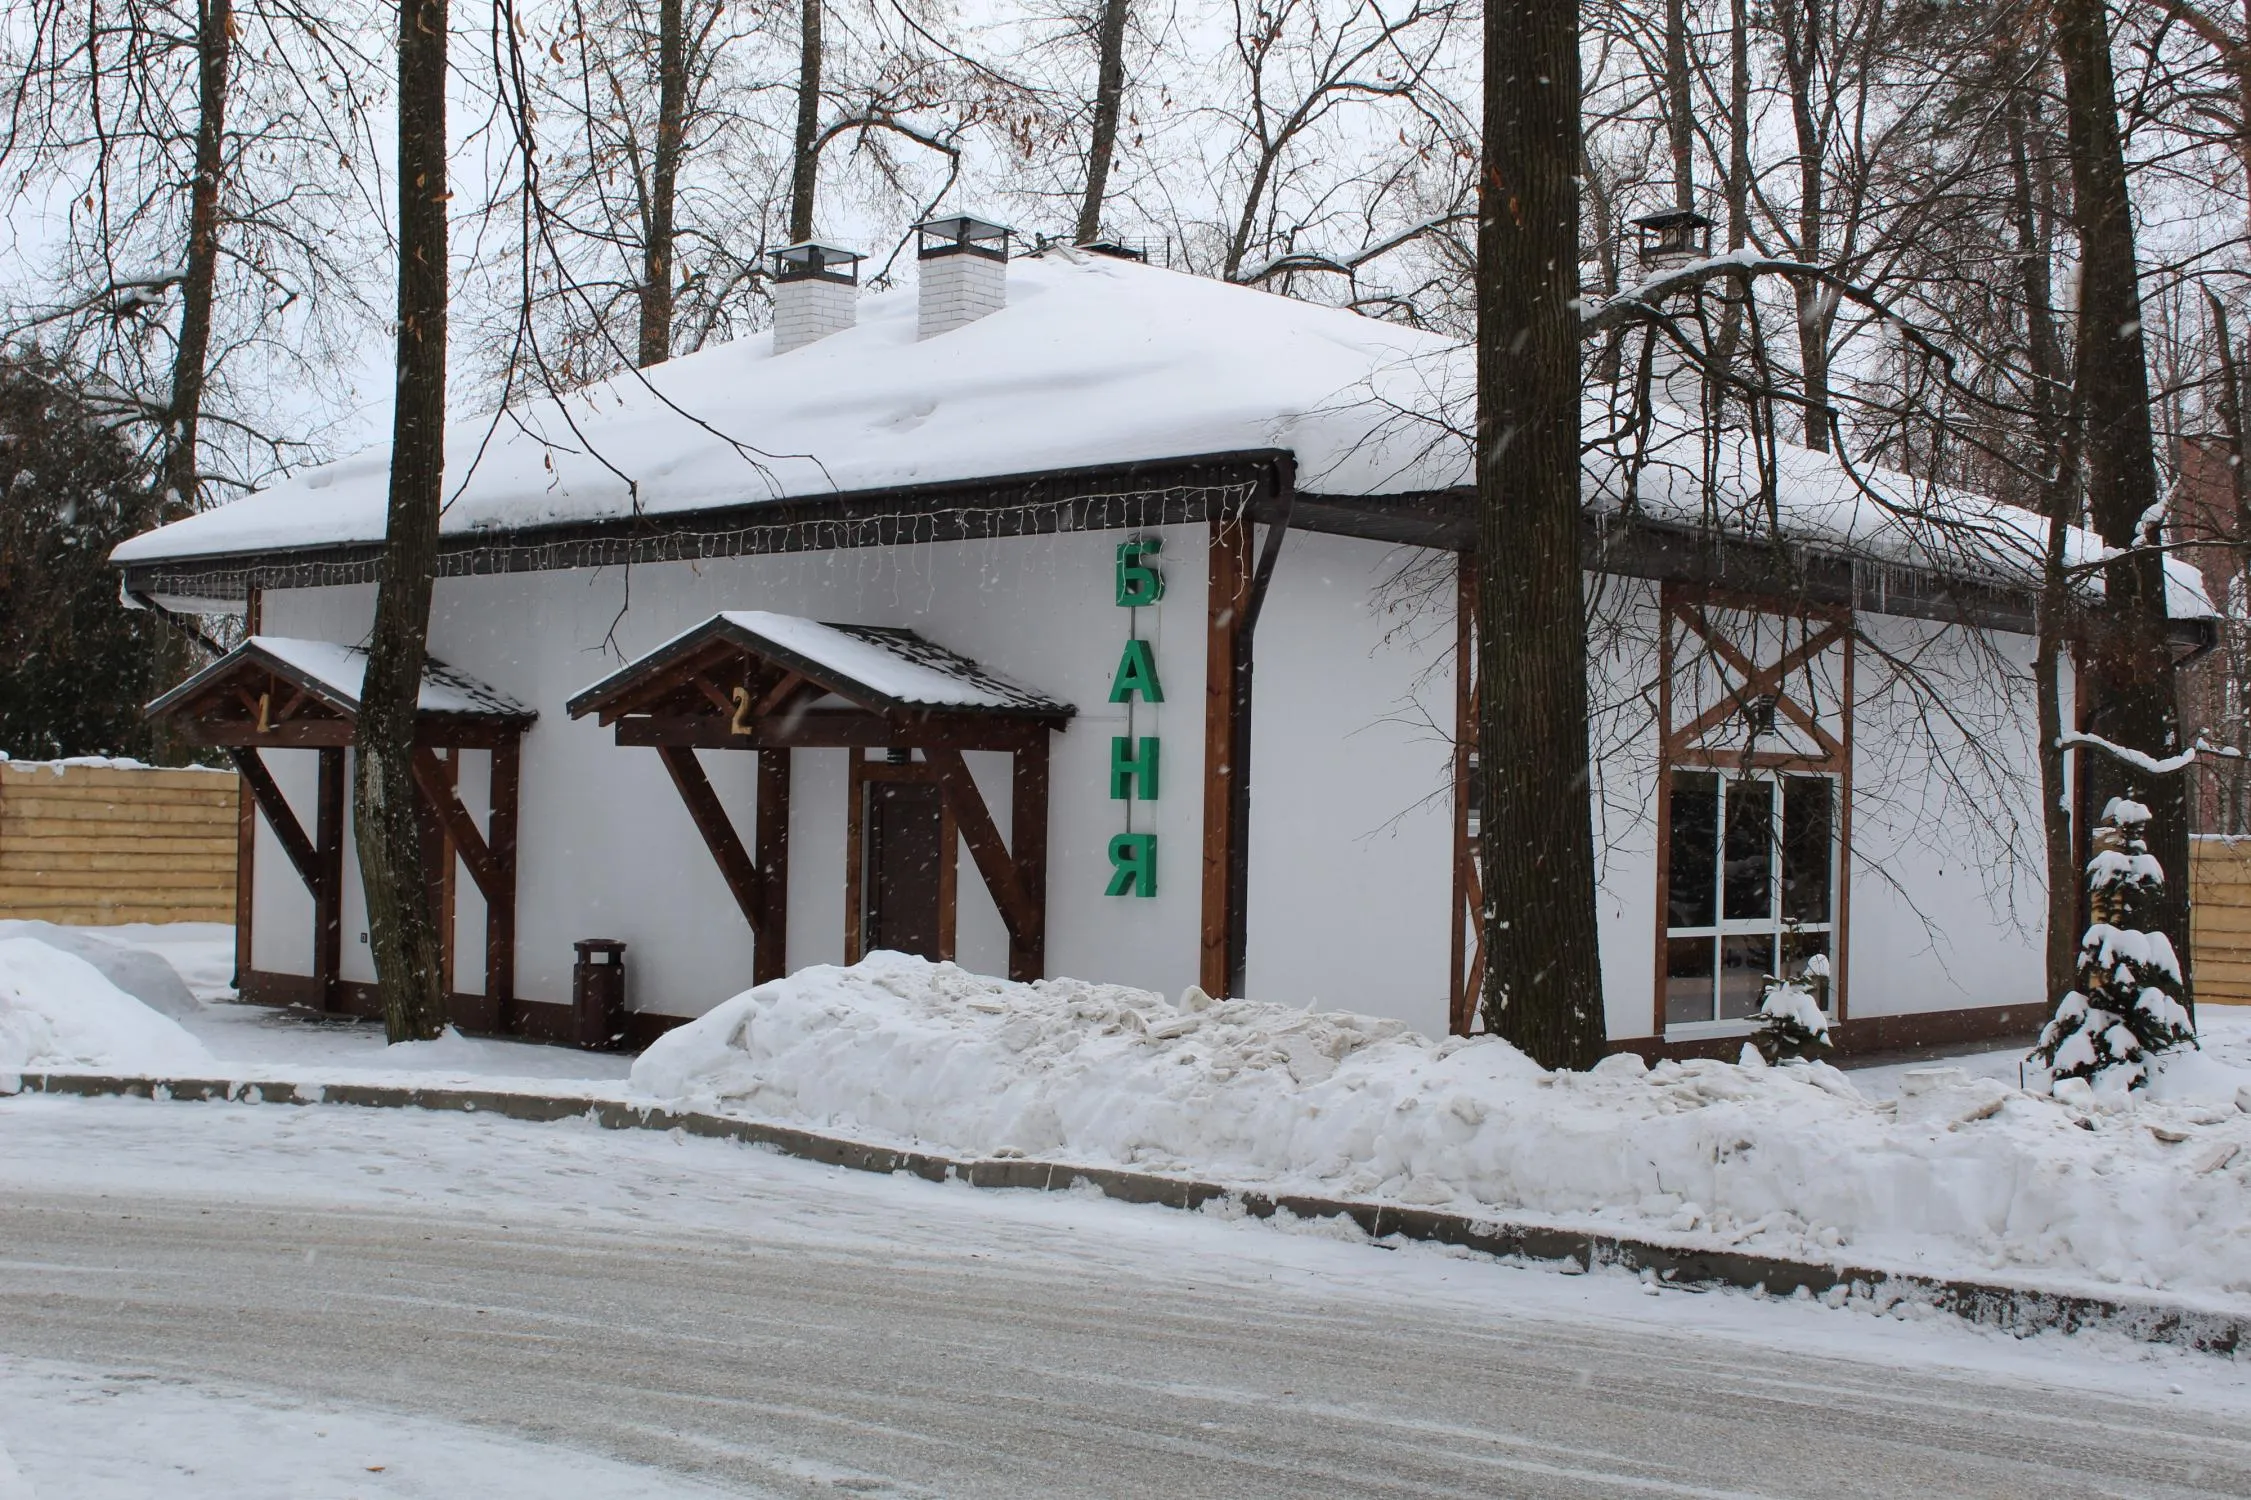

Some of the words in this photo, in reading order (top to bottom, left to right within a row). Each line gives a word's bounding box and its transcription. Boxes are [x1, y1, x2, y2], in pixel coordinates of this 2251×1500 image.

[257, 692, 271, 733] 1
[731, 686, 753, 735] 2
[1105, 541, 1165, 898] БАНЯ
